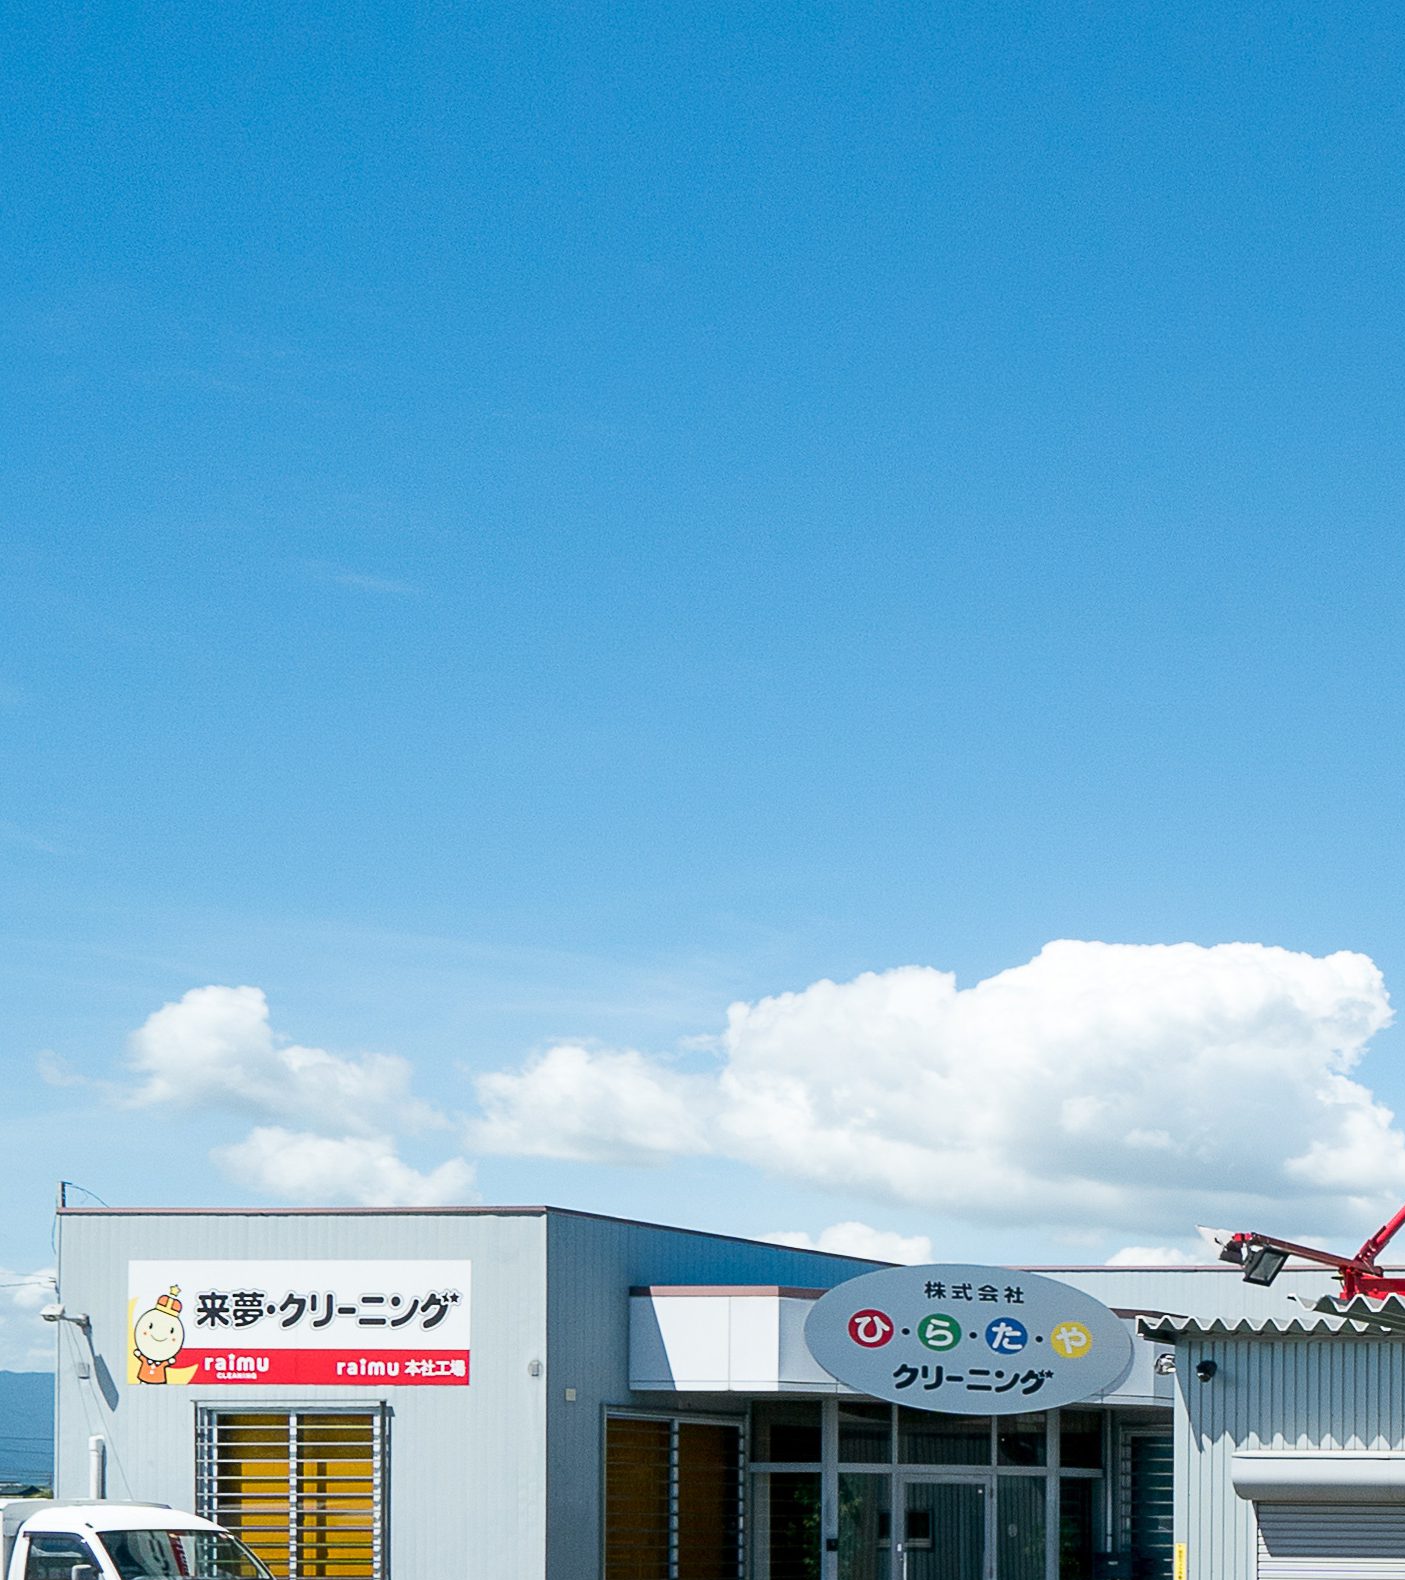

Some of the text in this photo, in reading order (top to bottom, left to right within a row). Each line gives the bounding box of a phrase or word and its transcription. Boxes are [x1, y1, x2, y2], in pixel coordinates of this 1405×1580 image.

[924, 1280, 1025, 1304] 株式会社
[196, 1290, 460, 1330] 来夢・クリーニング
[204, 1353, 270, 1372] raimu
[336, 1358, 467, 1377] raimu 本社工場
[893, 1363, 1055, 1395] クリーニング
